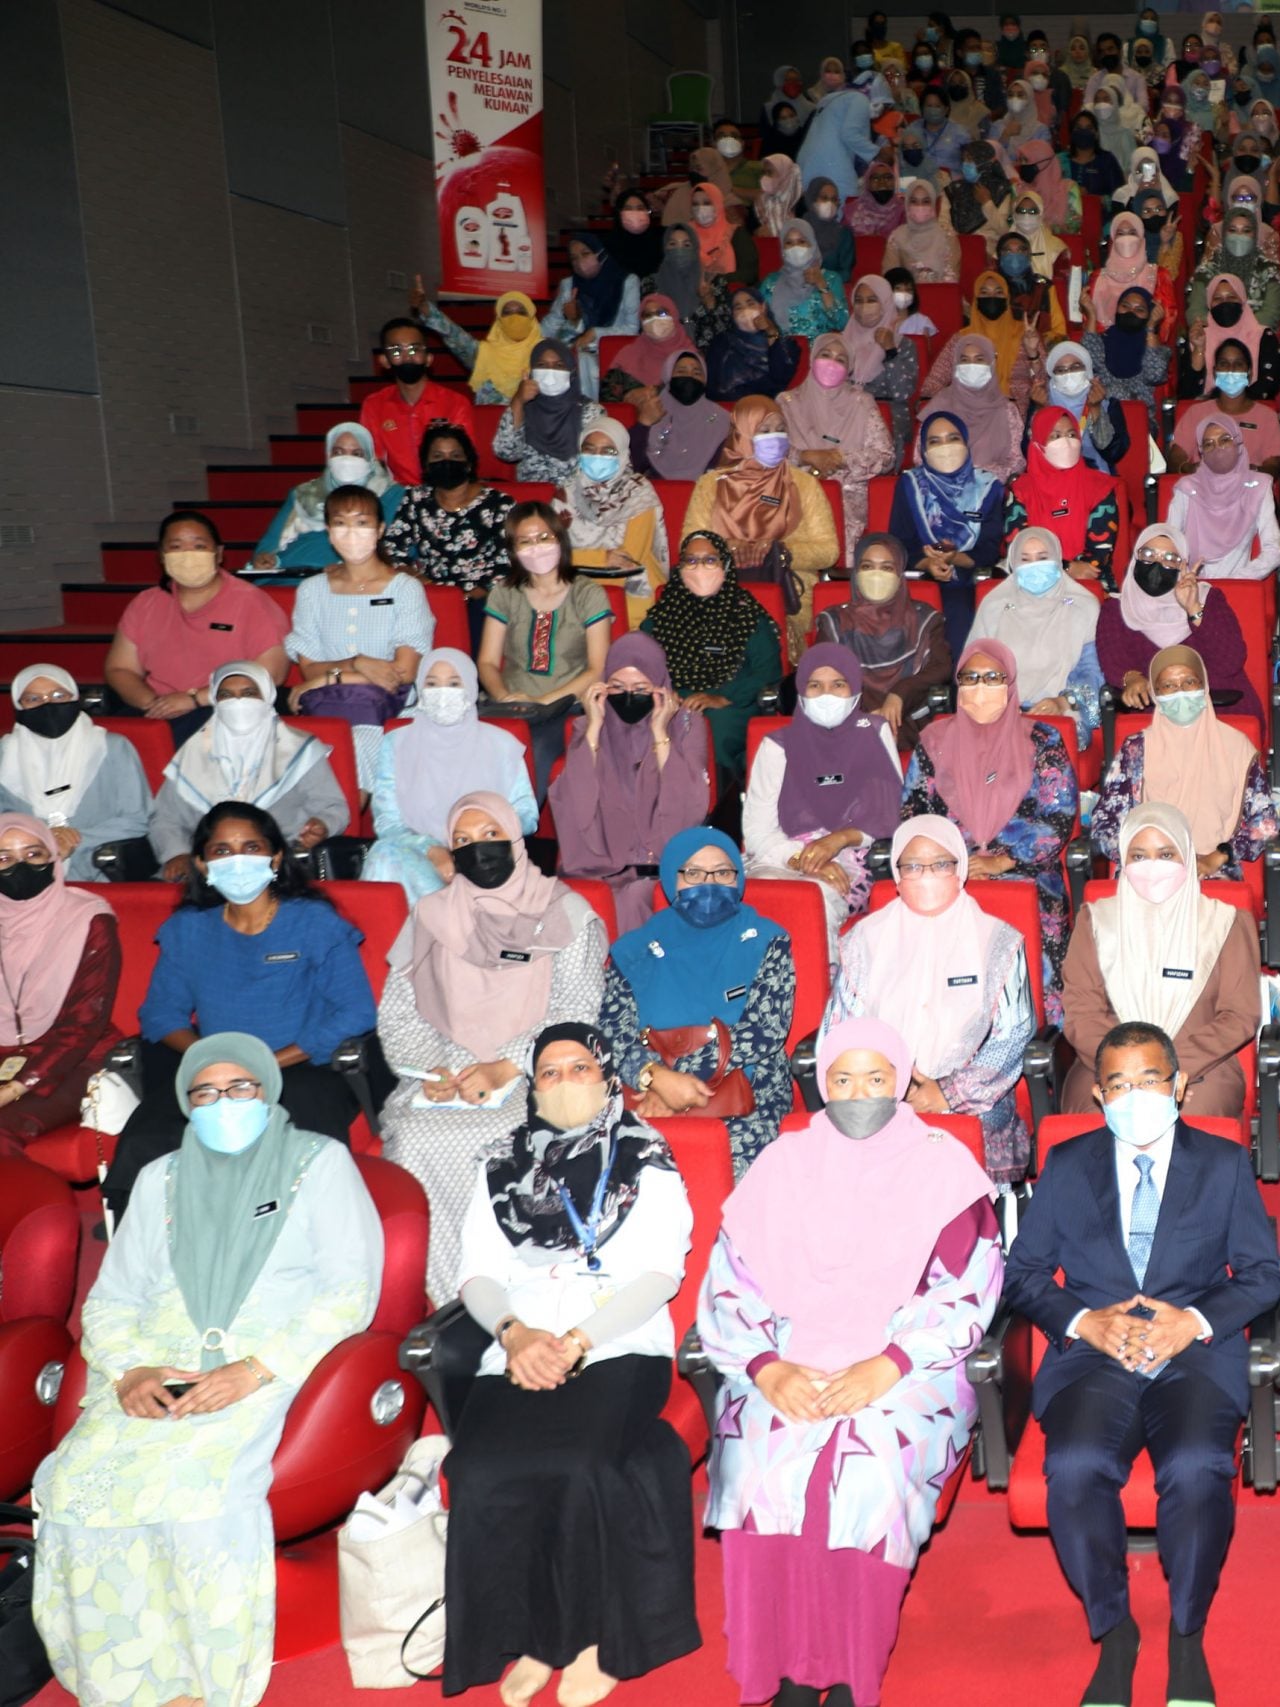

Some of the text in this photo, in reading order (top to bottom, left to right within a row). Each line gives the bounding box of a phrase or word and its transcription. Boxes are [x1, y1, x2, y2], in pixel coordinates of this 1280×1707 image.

[446, 25, 532, 70] 24 JAM
[448, 65, 533, 90] PENYELESAIAN
[473, 83, 533, 103] MELAWAN
[484, 98, 529, 115] KUMAN
